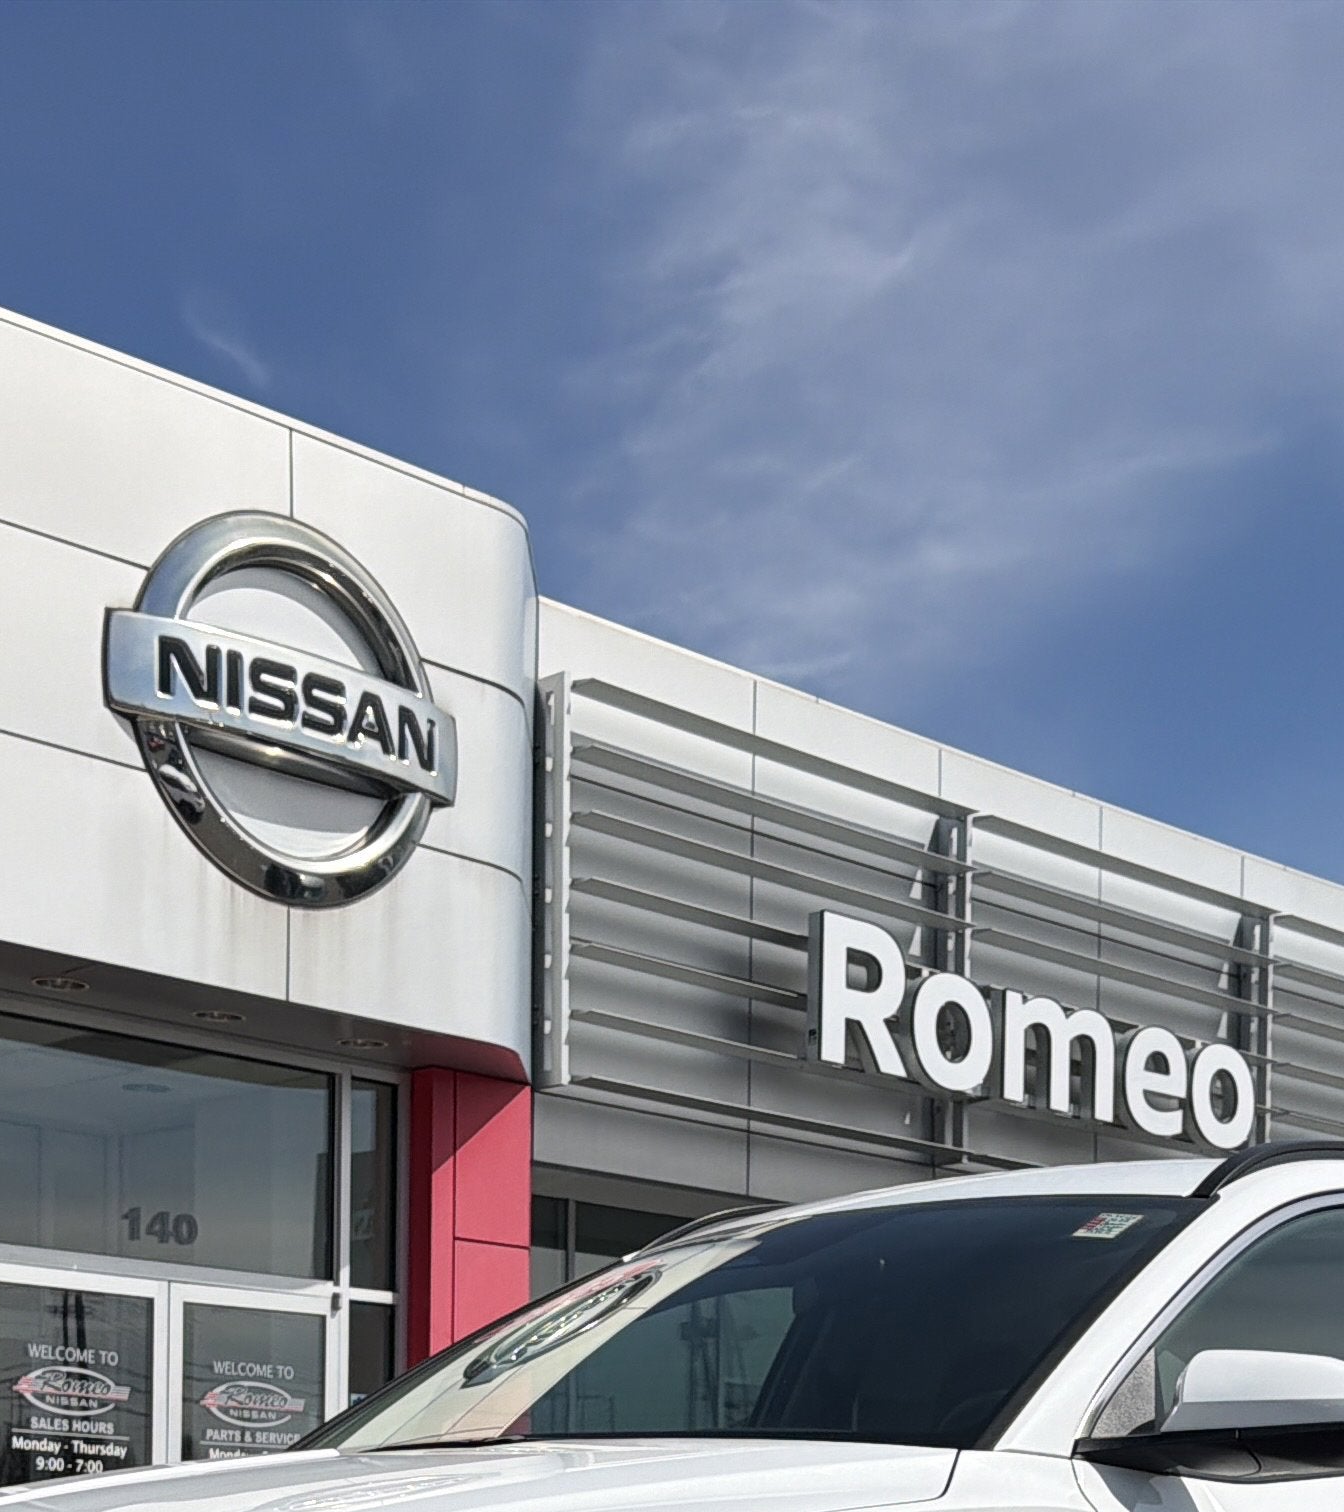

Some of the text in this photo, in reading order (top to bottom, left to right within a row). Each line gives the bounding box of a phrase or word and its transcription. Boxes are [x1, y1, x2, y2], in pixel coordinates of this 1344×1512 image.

[156, 635, 439, 777] NISSAN
[816, 908, 1255, 1150] Romeo
[120, 1206, 199, 1246] 140
[27, 1343, 119, 1367] WELCOME TO
[213, 1360, 295, 1380] WELCOME TO
[39, 1371, 112, 1396] Romeo
[45, 1395, 99, 1409] NISSAN
[222, 1385, 289, 1409] Romeo
[30, 1416, 115, 1435] SALES HOURS
[229, 1409, 277, 1420] NISSAN
[11, 1435, 62, 1455] Monday
[71, 1440, 128, 1459] Thursday
[206, 1428, 301, 1446] PARTS & SERVICE
[208, 1447, 249, 1460] Mond
[36, 1456, 65, 1471] 9:00
[75, 1459, 103, 1474] 7:00
